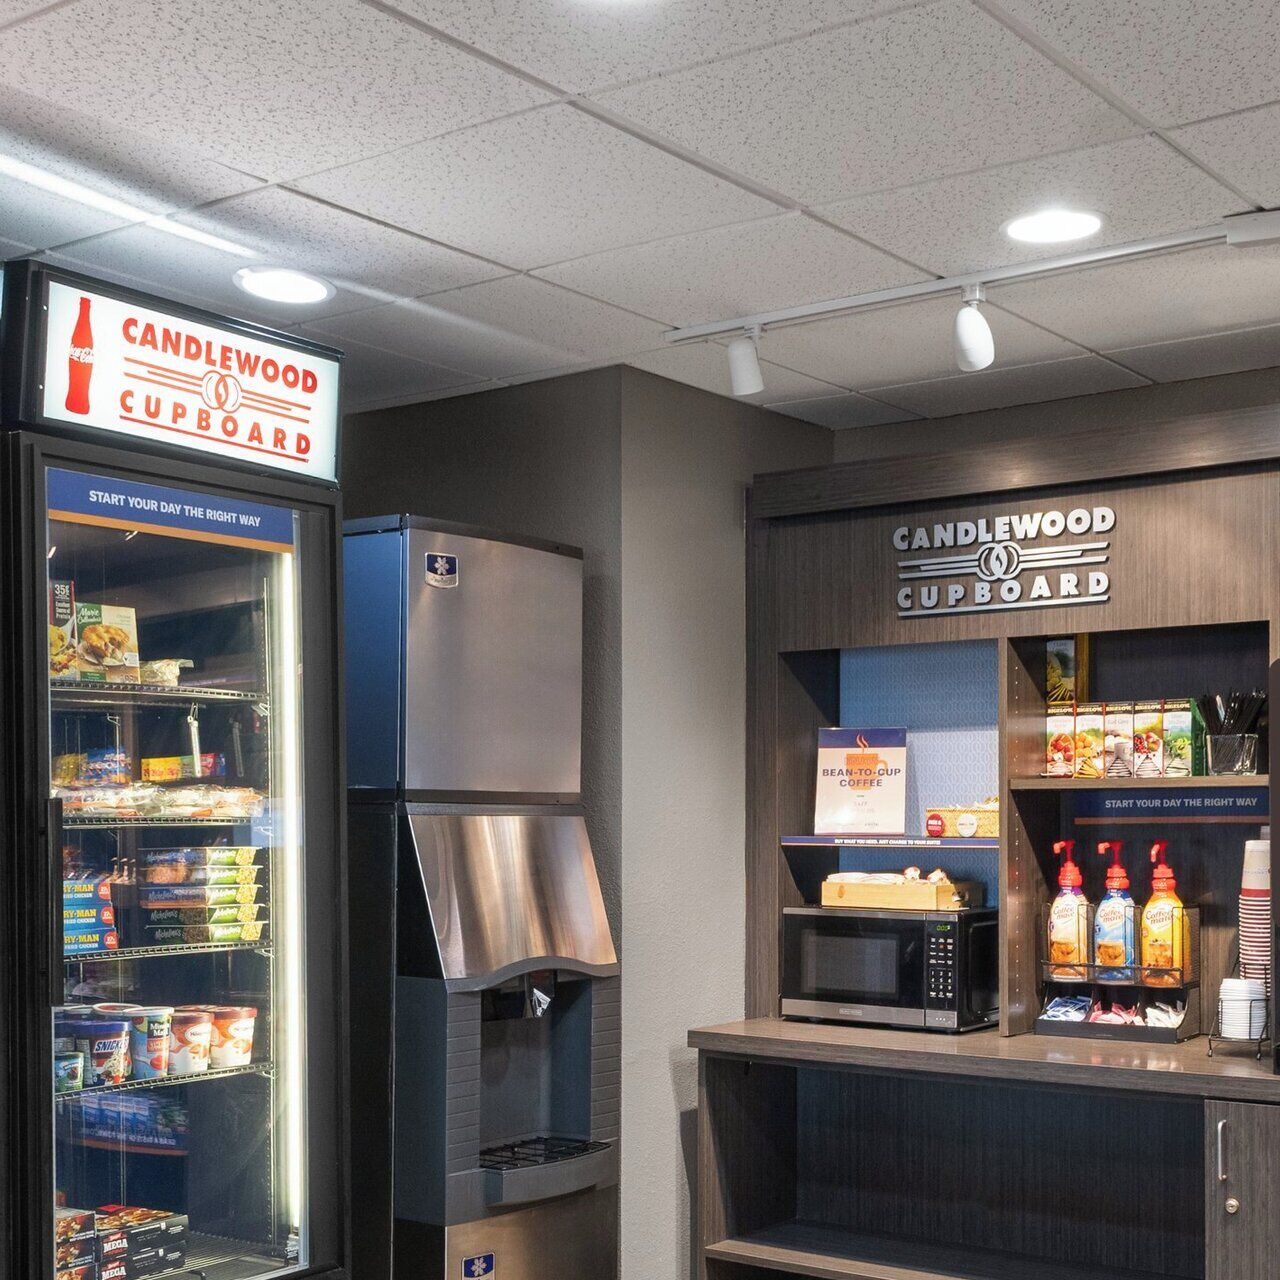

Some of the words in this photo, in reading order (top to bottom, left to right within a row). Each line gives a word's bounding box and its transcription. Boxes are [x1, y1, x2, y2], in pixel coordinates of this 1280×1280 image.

[121, 317, 318, 395] CANDLEWOOD
[120, 389, 311, 456] CUPBOARD
[89, 488, 125, 507] START
[128, 495, 158, 511] YOUR
[159, 500, 182, 515] DAY
[183, 504, 205, 518] THE
[207, 507, 238, 523] RIGHT
[240, 512, 261, 527] WAY
[893, 506, 1116, 550] CANDLEWOOD
[897, 571, 1109, 608] CUPBOARD
[822, 768, 901, 777] BEAN-TO-CUP
[839, 779, 883, 787] COFFEE
[1105, 800, 1133, 809] START
[1136, 800, 1160, 808] YOUR
[1162, 799, 1182, 808] DAY
[1184, 799, 1203, 807] THE
[1205, 798, 1233, 807] RIGHT
[1236, 798, 1257, 807] WAY
